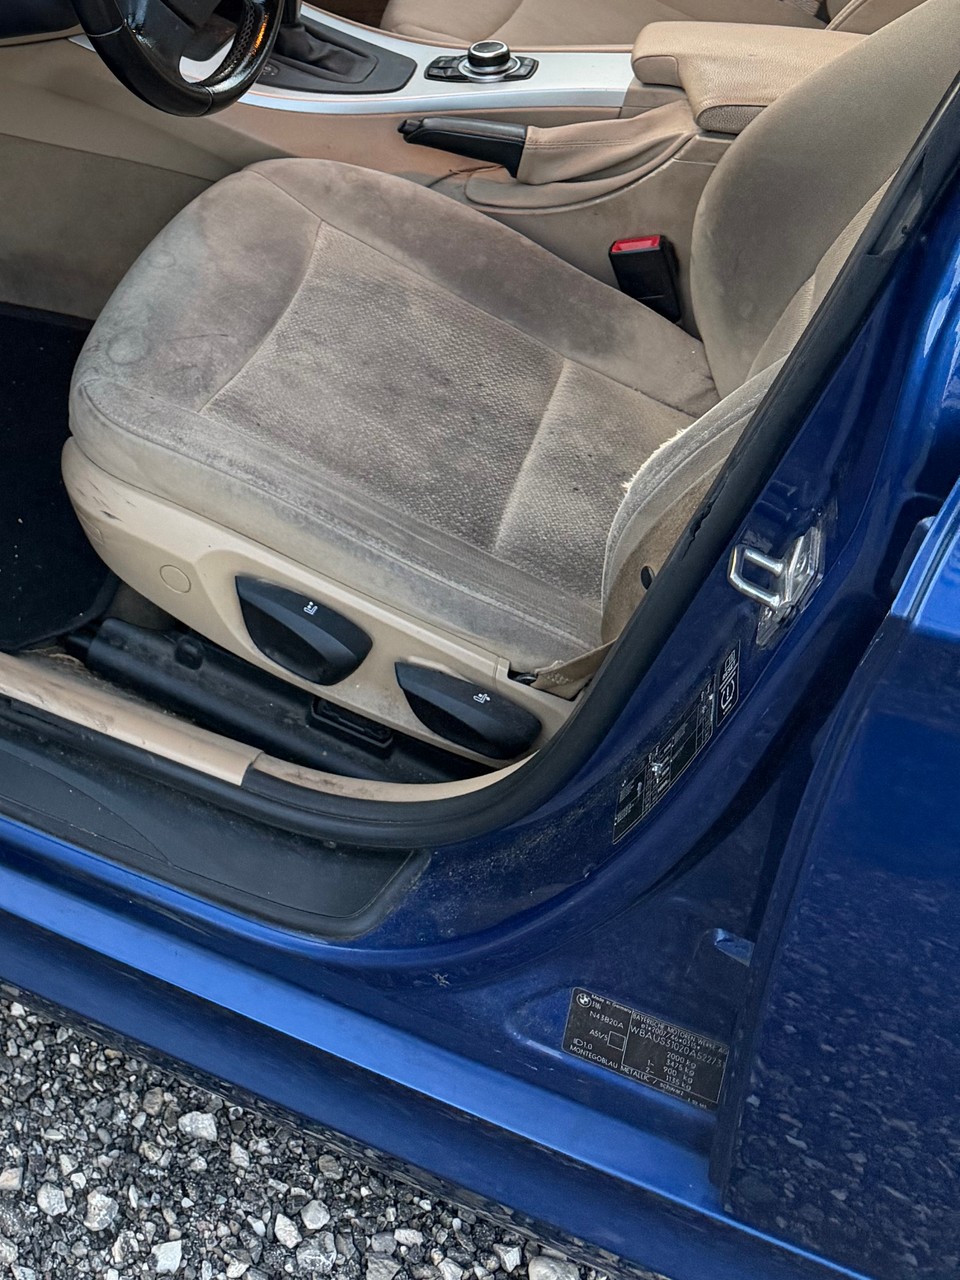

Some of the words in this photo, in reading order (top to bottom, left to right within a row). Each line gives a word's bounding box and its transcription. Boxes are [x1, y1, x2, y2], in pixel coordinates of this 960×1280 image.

[589, 1010, 624, 1029] N43B20A
[569, 1044, 618, 1069] MONTEGOBLAU
[666, 1051, 685, 1063] 2000
[685, 1058, 696, 1069] kg
[682, 1074, 693, 1084] kg
[684, 1066, 694, 1077] kg
